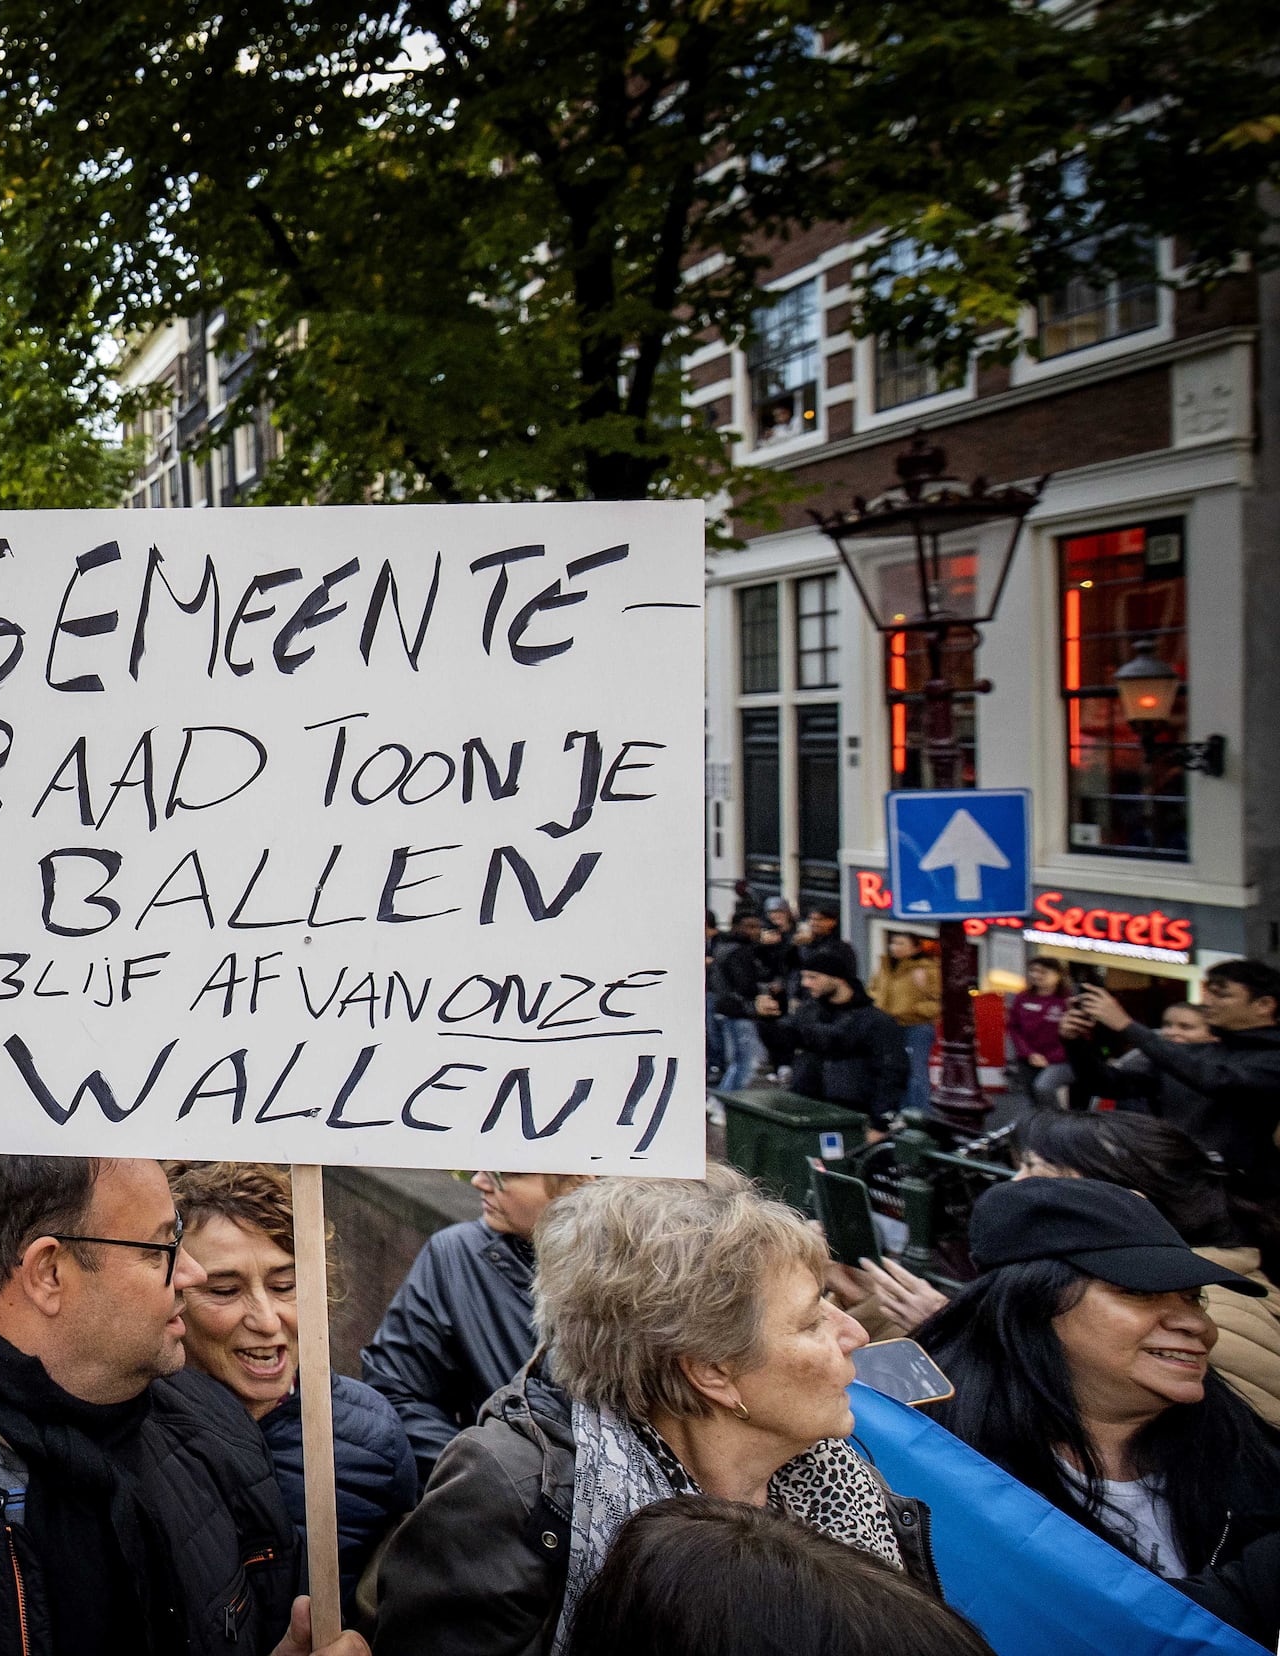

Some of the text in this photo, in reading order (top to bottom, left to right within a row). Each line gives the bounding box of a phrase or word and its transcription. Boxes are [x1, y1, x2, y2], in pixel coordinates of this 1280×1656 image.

[304, 712, 527, 808] TOON
[536, 730, 667, 839] JE
[38, 845, 603, 938] BALLEN
[1033, 891, 1193, 950] Secrets
[190, 952, 283, 1018] AF
[298, 967, 433, 1030] VAN
[438, 970, 668, 1030] ONZE
[3, 1034, 678, 1161] WALLEN!!
